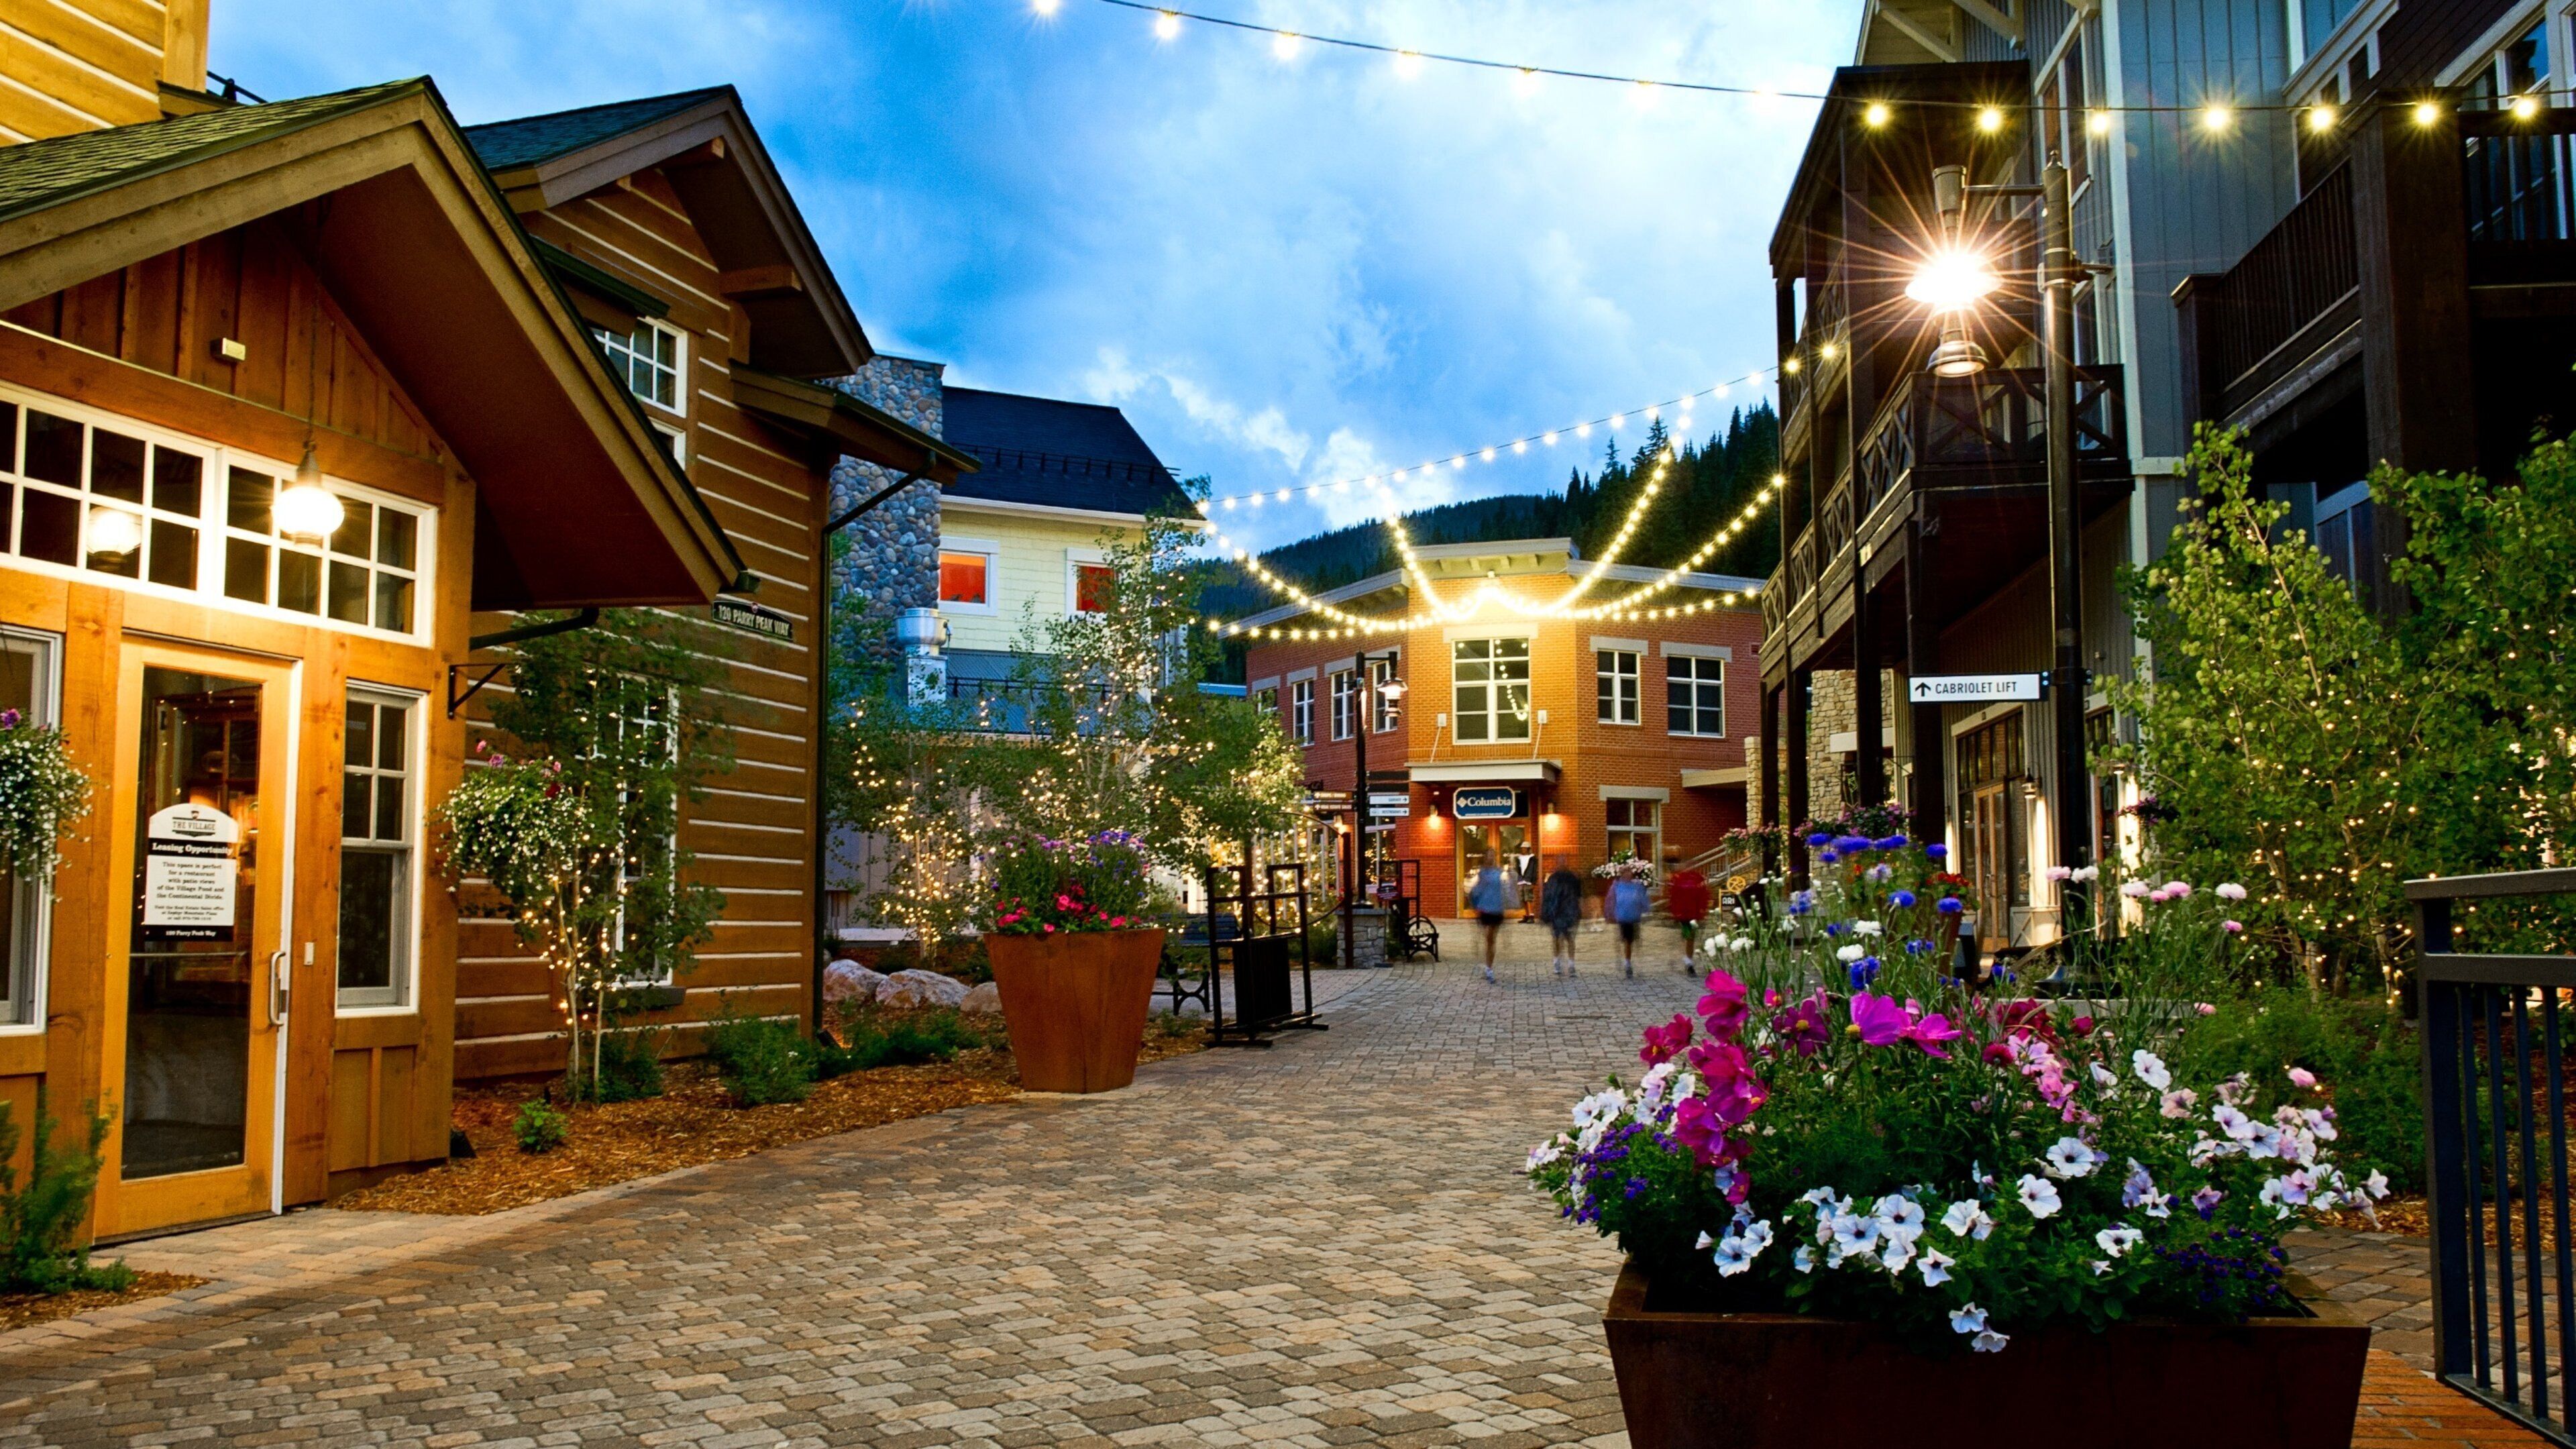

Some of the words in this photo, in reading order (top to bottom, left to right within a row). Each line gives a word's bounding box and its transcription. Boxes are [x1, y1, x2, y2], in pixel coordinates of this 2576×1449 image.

[718, 605, 731, 621] 120
[733, 609, 755, 627] PARRY
[755, 616, 773, 632] PEAK
[773, 620, 790, 636] WAY
[1935, 682, 1992, 694] CABRIOLET
[1996, 682, 2017, 692] LIFT
[1467, 796, 1512, 806] Columbia
[173, 821, 186, 829] THE
[189, 822, 215, 830] VILLAGE
[152, 843, 184, 853] Leasing
[184, 845, 233, 856] Opportunity
